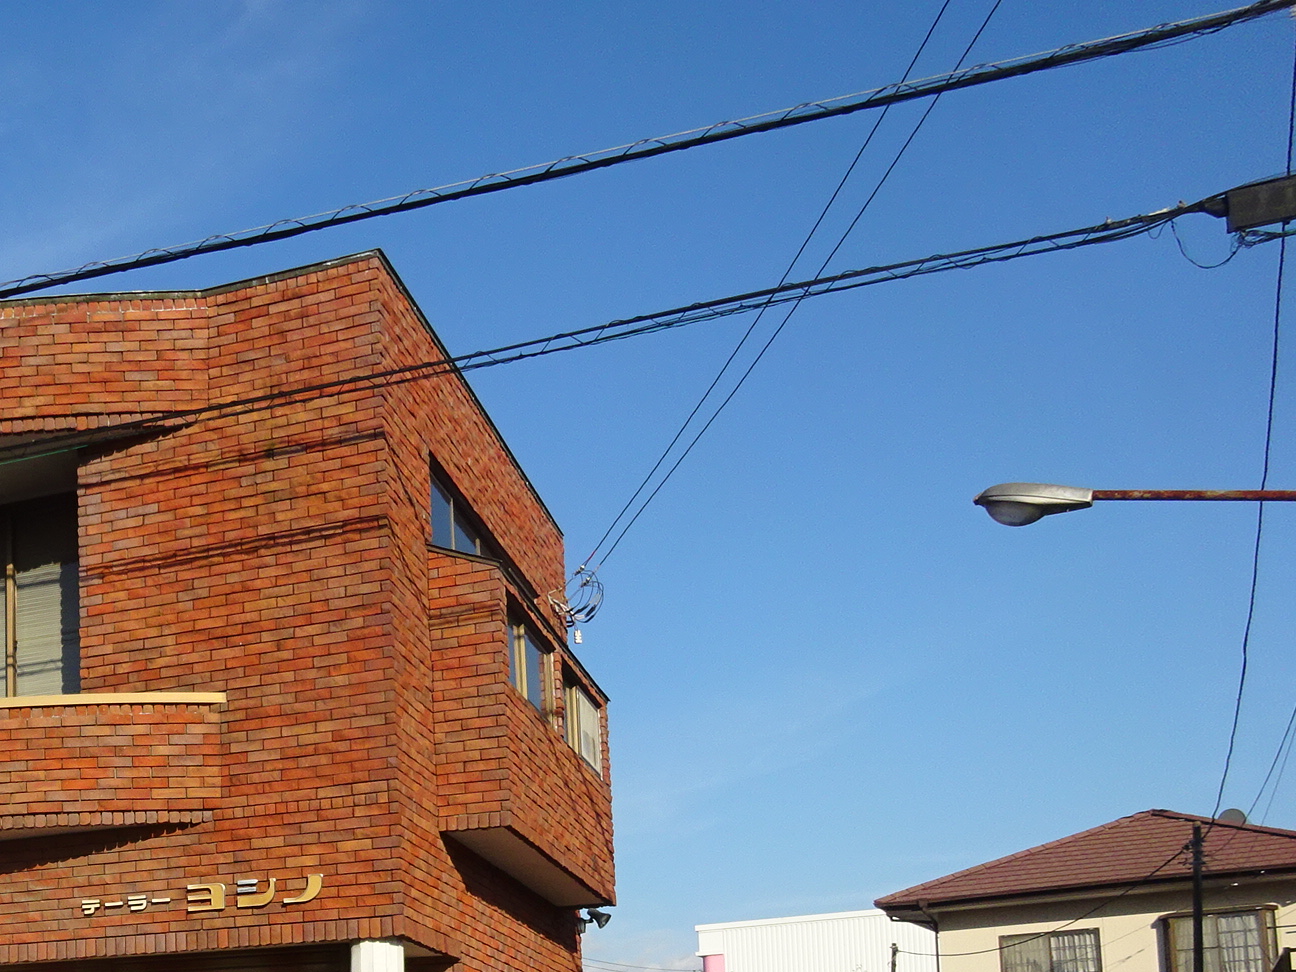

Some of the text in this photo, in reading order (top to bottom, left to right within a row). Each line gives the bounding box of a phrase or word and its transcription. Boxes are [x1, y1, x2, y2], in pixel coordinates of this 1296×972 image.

[81, 873, 324, 915] テーラーヨシノ
